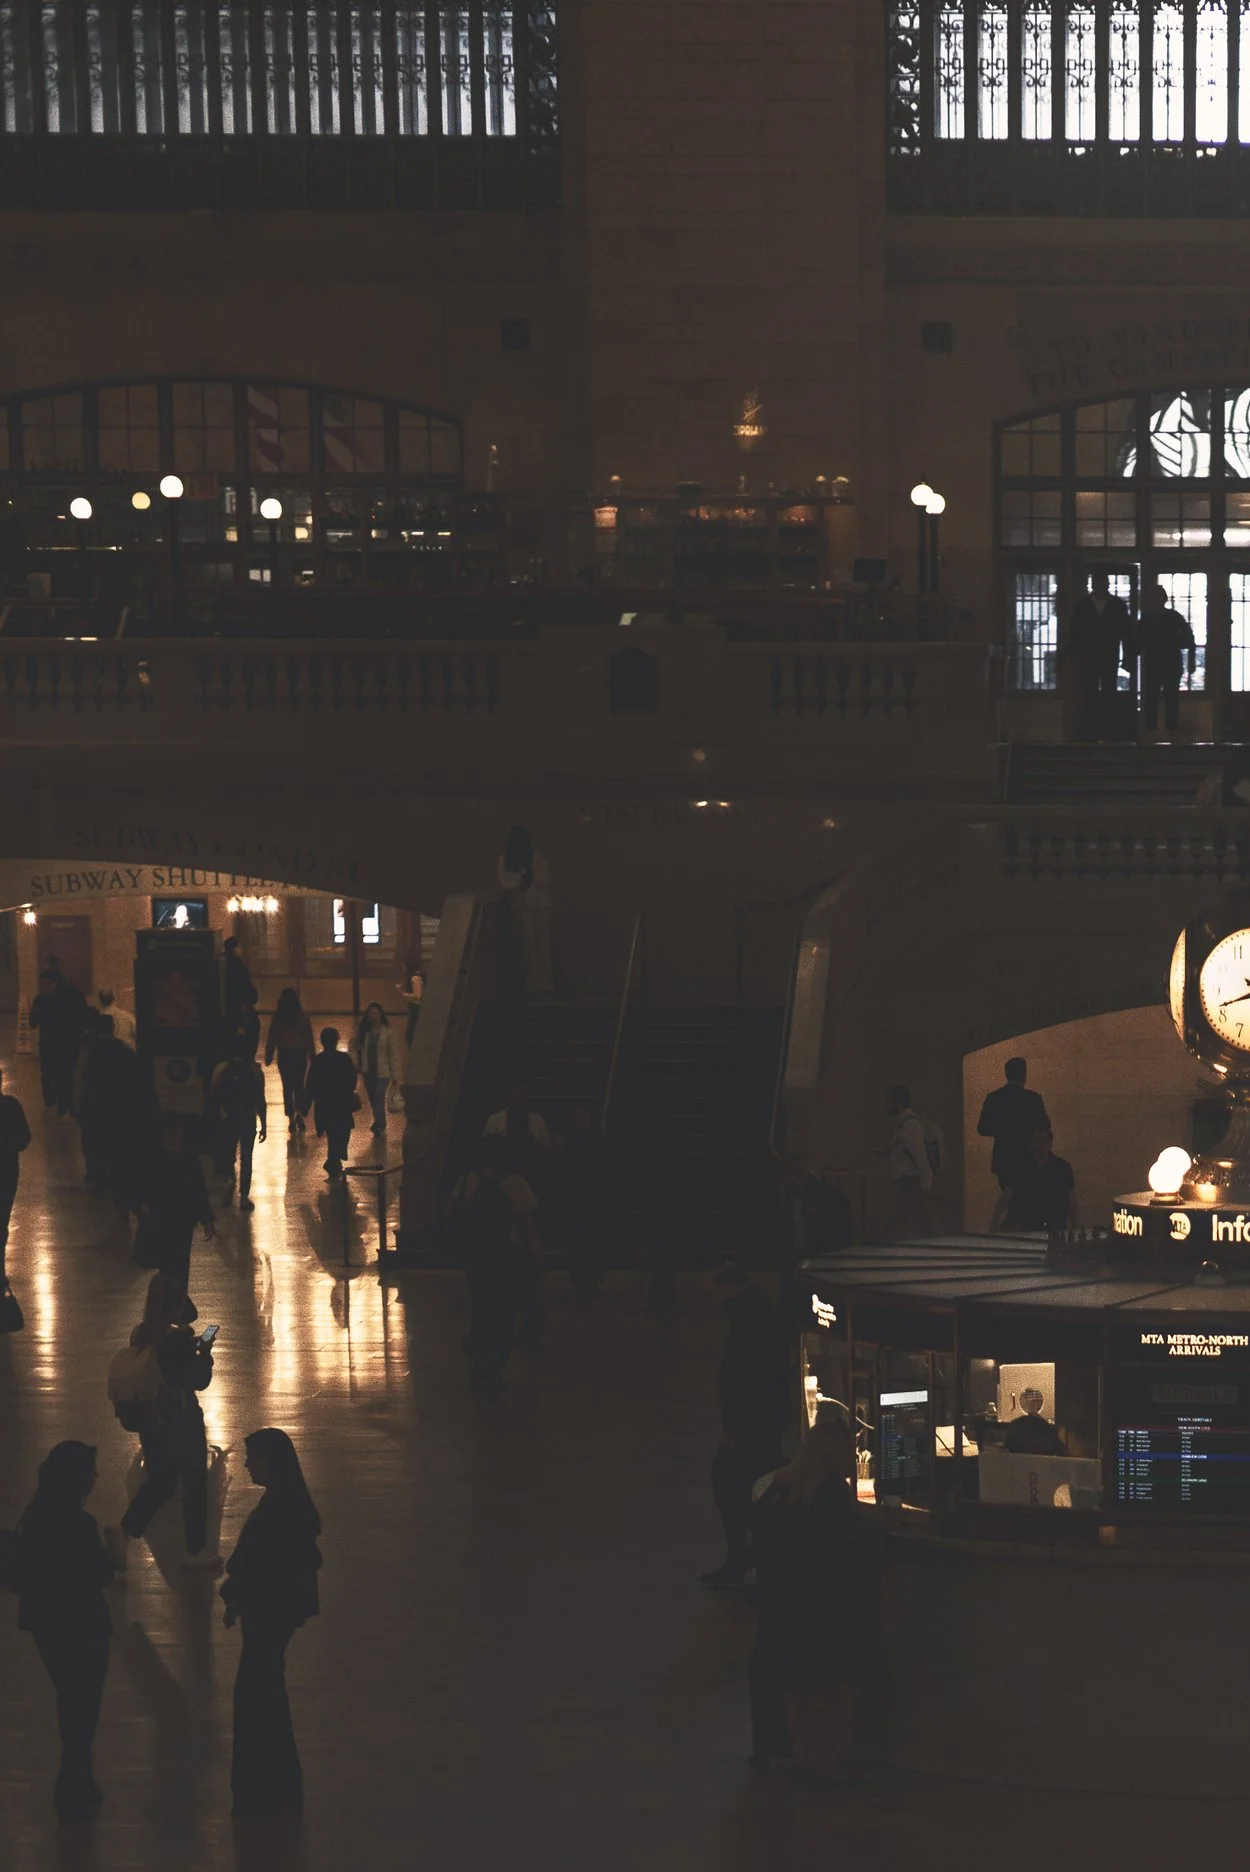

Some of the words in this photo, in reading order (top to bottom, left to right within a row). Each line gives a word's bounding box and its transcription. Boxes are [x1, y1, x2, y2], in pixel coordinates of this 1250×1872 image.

[31, 868, 143, 897] SUBWAY
[1218, 1009, 1228, 1024] 8
[1235, 1022, 1244, 1038] 7
[1140, 1334, 1164, 1345] MTA
[1167, 1334, 1249, 1346] METRO-NORTH
[1168, 1345, 1221, 1356] ARRIVALS
